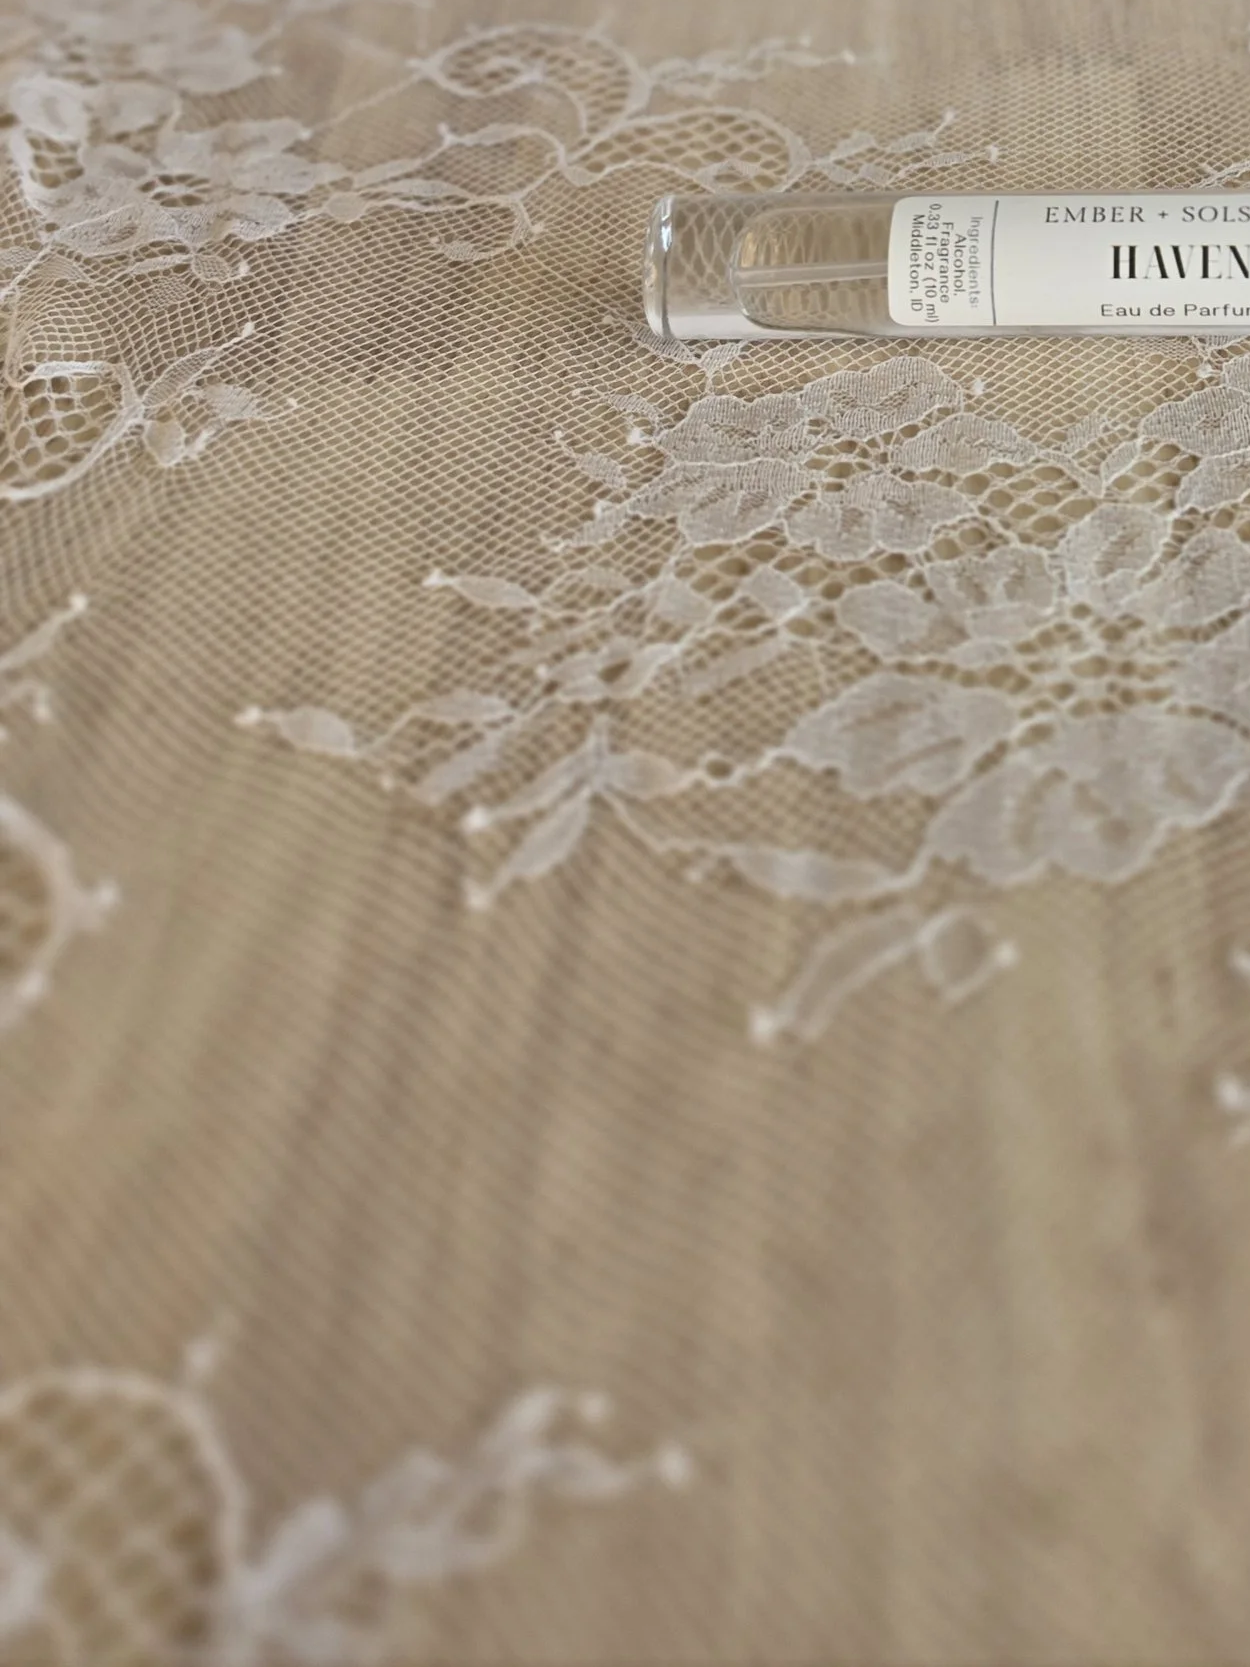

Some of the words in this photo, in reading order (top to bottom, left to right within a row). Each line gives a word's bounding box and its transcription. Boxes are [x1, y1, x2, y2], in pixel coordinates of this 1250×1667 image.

[926, 203, 942, 230] 0.33
[1045, 206, 1145, 223] EMBER
[925, 236, 938, 246] fl
[924, 252, 934, 270] oz
[937, 222, 954, 303] Fragrance
[966, 216, 983, 308] Ingredients:
[922, 277, 938, 298] (10
[910, 299, 923, 312] ID
[925, 304, 940, 323] ml)
[1100, 303, 1141, 317] Eau
[1149, 303, 1176, 316] de
